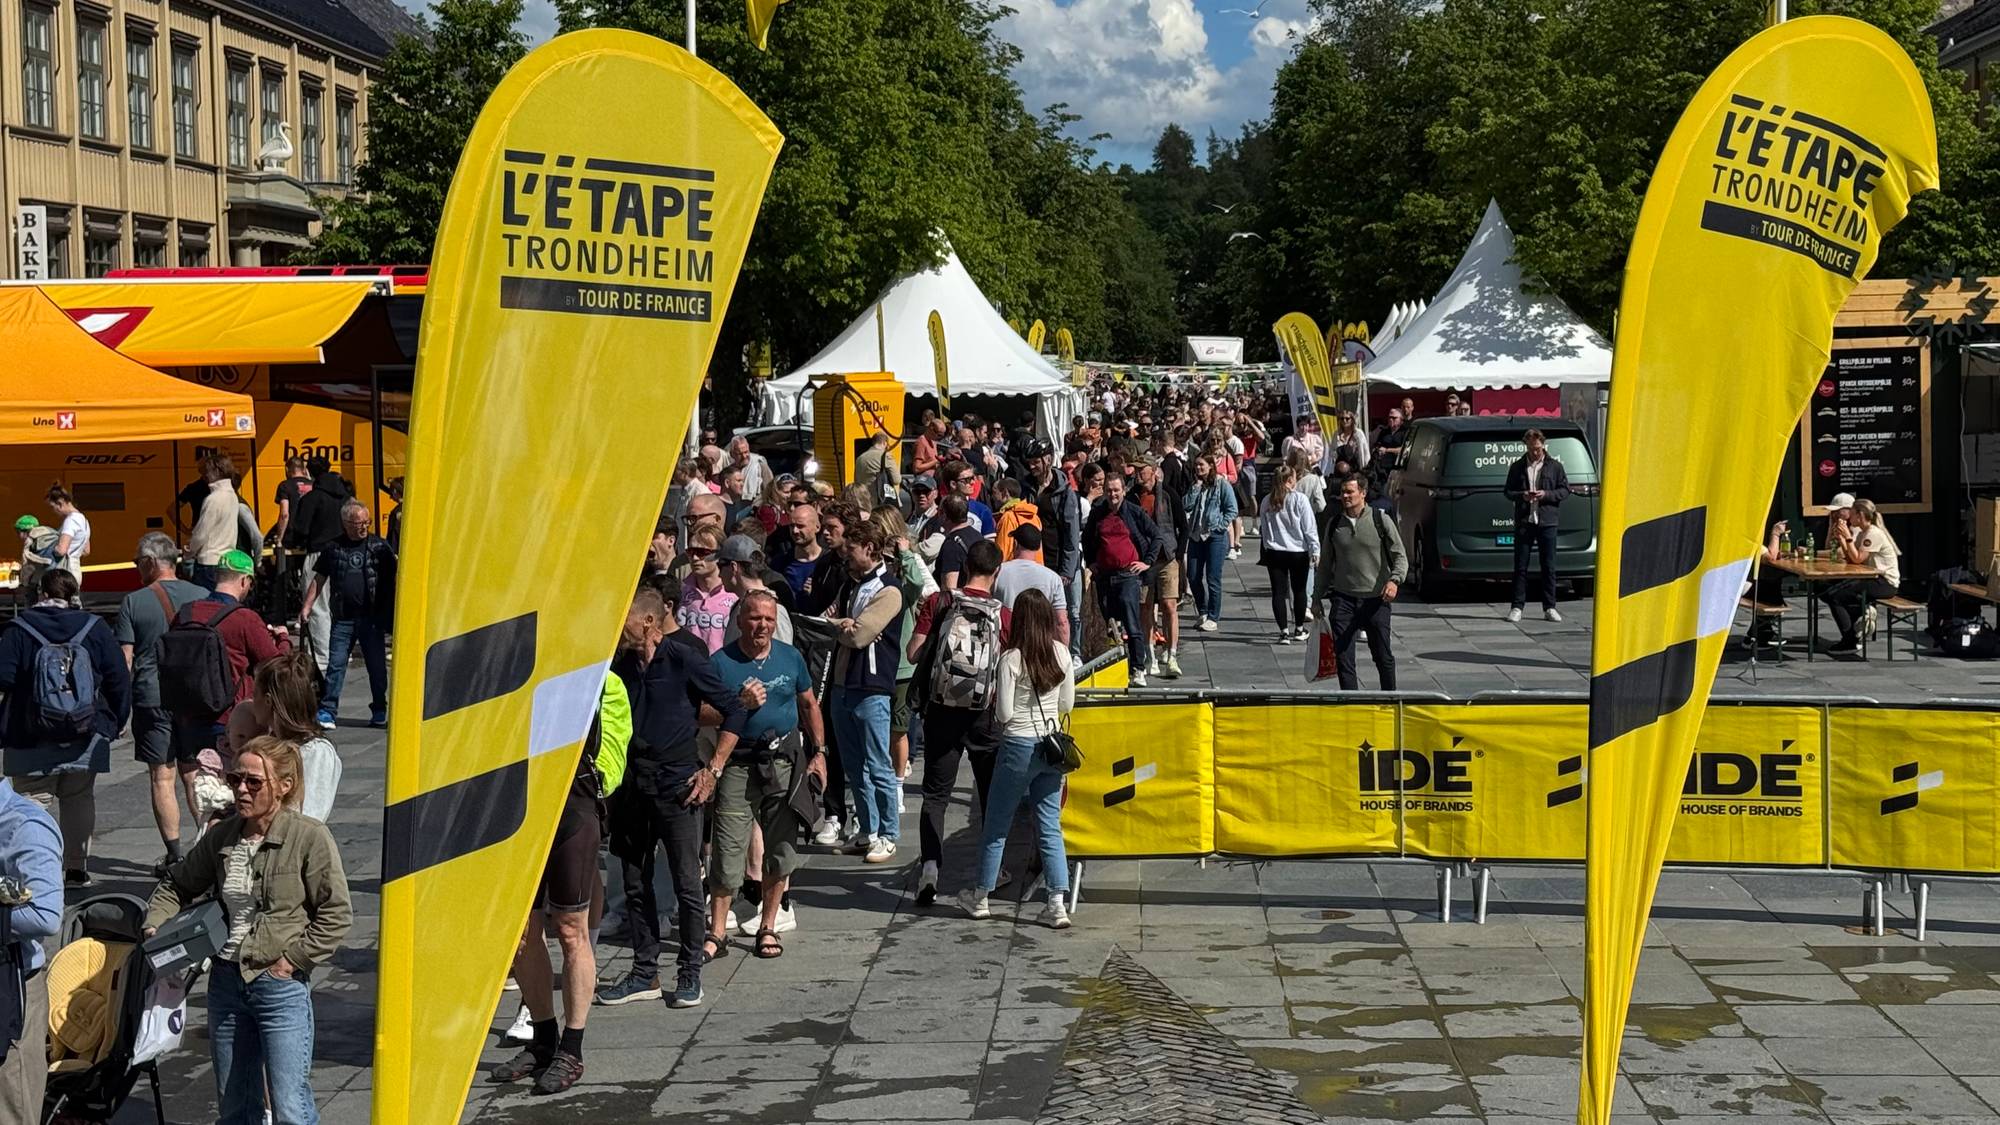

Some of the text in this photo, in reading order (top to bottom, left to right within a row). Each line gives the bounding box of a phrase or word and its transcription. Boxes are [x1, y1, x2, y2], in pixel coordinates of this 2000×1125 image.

[1711, 163, 1868, 245] TRONDHEIM
[1750, 220, 1853, 271] BY TOUR DE FRANCE
[501, 233, 713, 283] TRONDHEIM
[565, 288, 706, 315] BY TOUR DE FRANCE
[33, 416, 55, 427] Uno
[184, 413, 206, 423] Uno
[1484, 443, 1499, 453] På
[64, 453, 158, 465] RIDLEY
[1475, 455, 1496, 468] god
[1360, 800, 1473, 812] HOUSE OF BRANDS
[1681, 804, 1803, 817] HOUSE OF BRANDS
